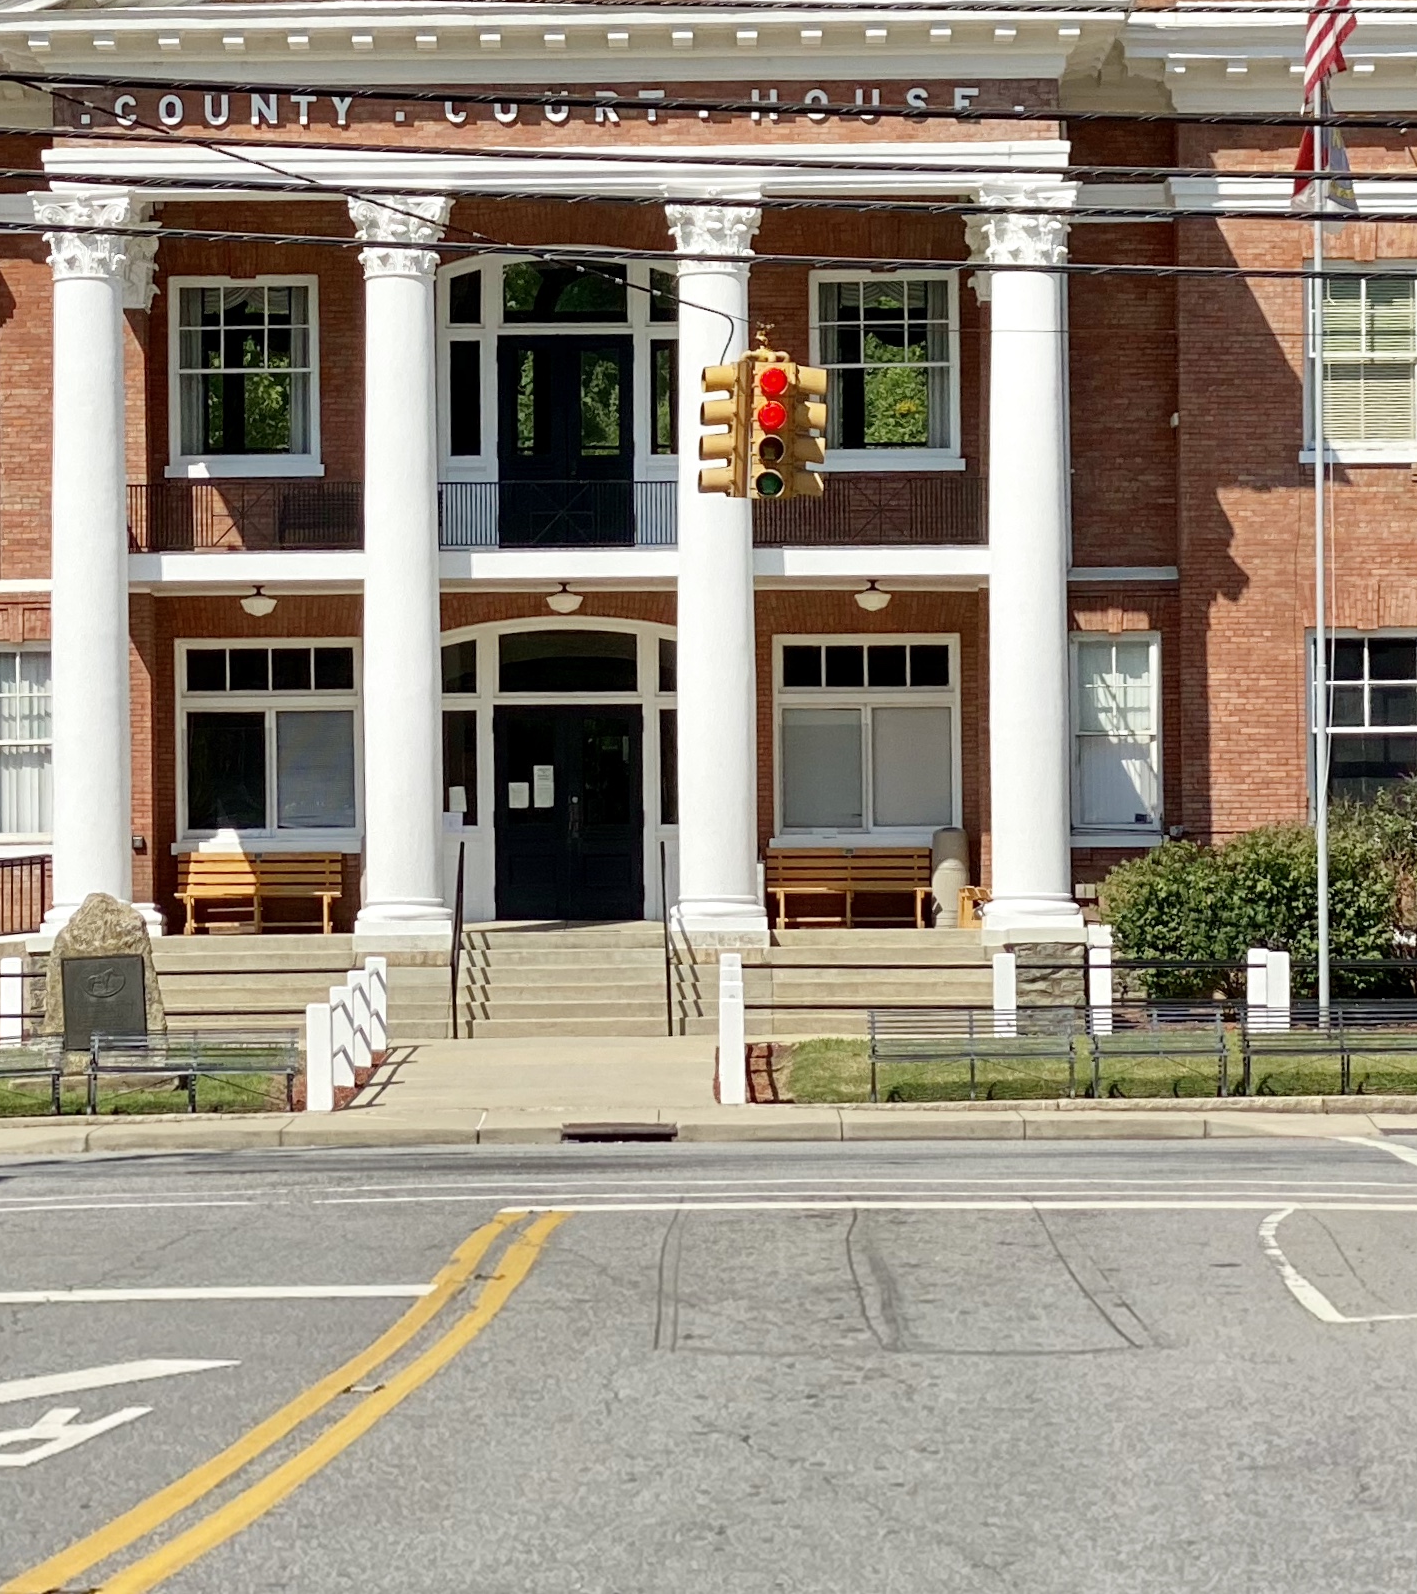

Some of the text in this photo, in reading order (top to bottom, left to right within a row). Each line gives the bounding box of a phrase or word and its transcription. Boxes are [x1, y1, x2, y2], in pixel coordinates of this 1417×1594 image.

[114, 87, 979, 126] COUNTY COURT HOUSE
